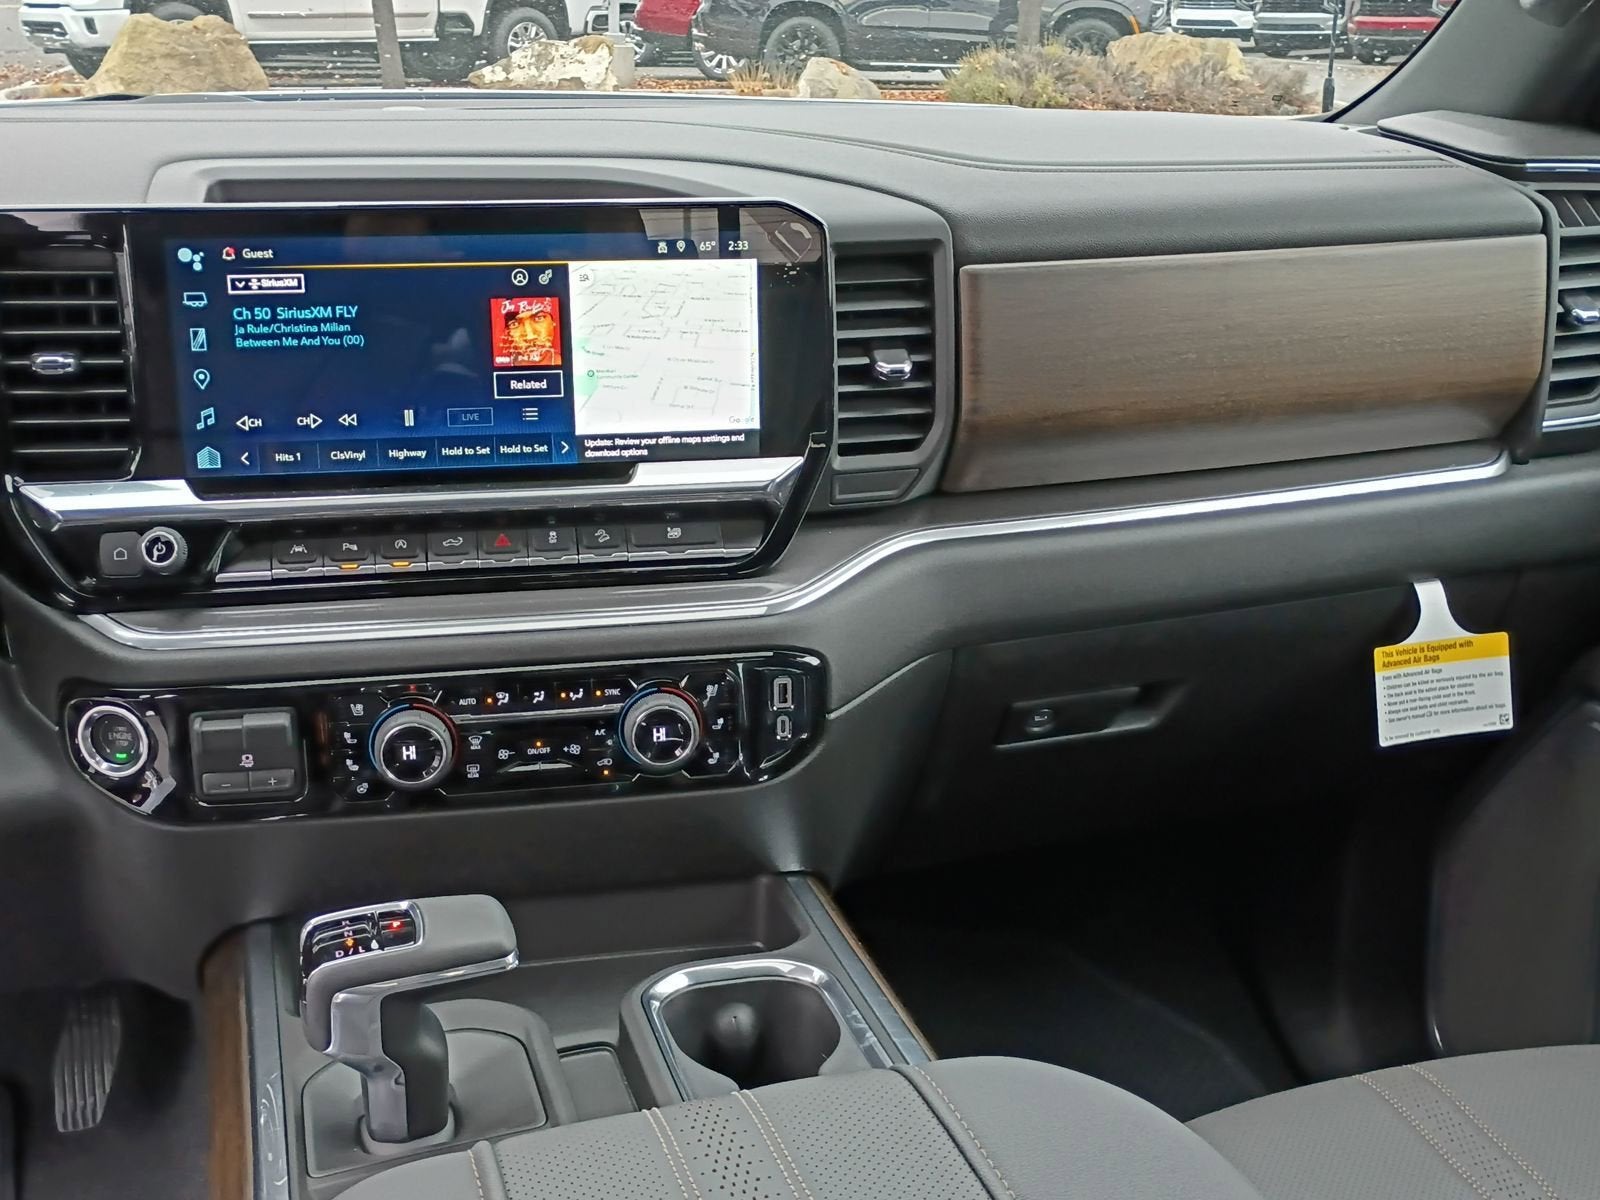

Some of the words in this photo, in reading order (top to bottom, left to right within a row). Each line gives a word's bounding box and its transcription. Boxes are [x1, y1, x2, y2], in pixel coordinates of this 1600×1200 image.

[728, 241, 749, 251] 2:33
[242, 248, 274, 258] Guest
[260, 278, 299, 288] SiriusXM
[233, 307, 251, 320] Ch
[254, 307, 271, 320] 50
[276, 306, 333, 319] SiriusXM
[335, 305, 358, 318] FLY
[234, 324, 245, 336] Ja
[247, 323, 318, 334] Rule/Christina
[320, 322, 351, 332] Milian
[236, 337, 280, 348] Between
[282, 336, 299, 346] Me
[300, 335, 320, 346] And
[322, 335, 341, 345] You
[343, 334, 364, 347] (00)
[510, 379, 547, 390] Related
[297, 416, 311, 426] CH
[462, 413, 480, 421] LIVE
[728, 415, 755, 424] Gogle
[249, 418, 263, 427] CH
[584, 437, 614, 448] Update:
[614, 437, 640, 446] Review
[640, 437, 657, 447] your
[658, 435, 681, 445] offline
[681, 435, 701, 445] maps
[702, 434, 730, 444] settings
[731, 433, 745, 442] and
[441, 446, 462, 456] Hold
[476, 446, 491, 455] Set
[500, 444, 521, 454] Hold
[533, 444, 548, 453] Set
[584, 448, 620, 458] download
[620, 447, 649, 458] options
[275, 453, 295, 462] Hits
[296, 452, 302, 461] 1
[330, 450, 366, 461] ClsVinyl
[388, 449, 427, 460] Highway
[1382, 650, 1394, 658] This
[1395, 646, 1418, 656] Vehicle
[1419, 645, 1425, 654] is
[1426, 641, 1457, 653] Equipped
[1458, 639, 1474, 649] with
[1382, 656, 1412, 668] Advanced
[1412, 655, 1422, 664] Air
[1423, 654, 1440, 663] Bags
[604, 688, 621, 697] SYNC
[458, 698, 477, 706] AUTO
[652, 727, 667, 742] HI
[402, 745, 417, 760] HI
[527, 746, 551, 755] ON/OFF
[343, 930, 353, 938] N
